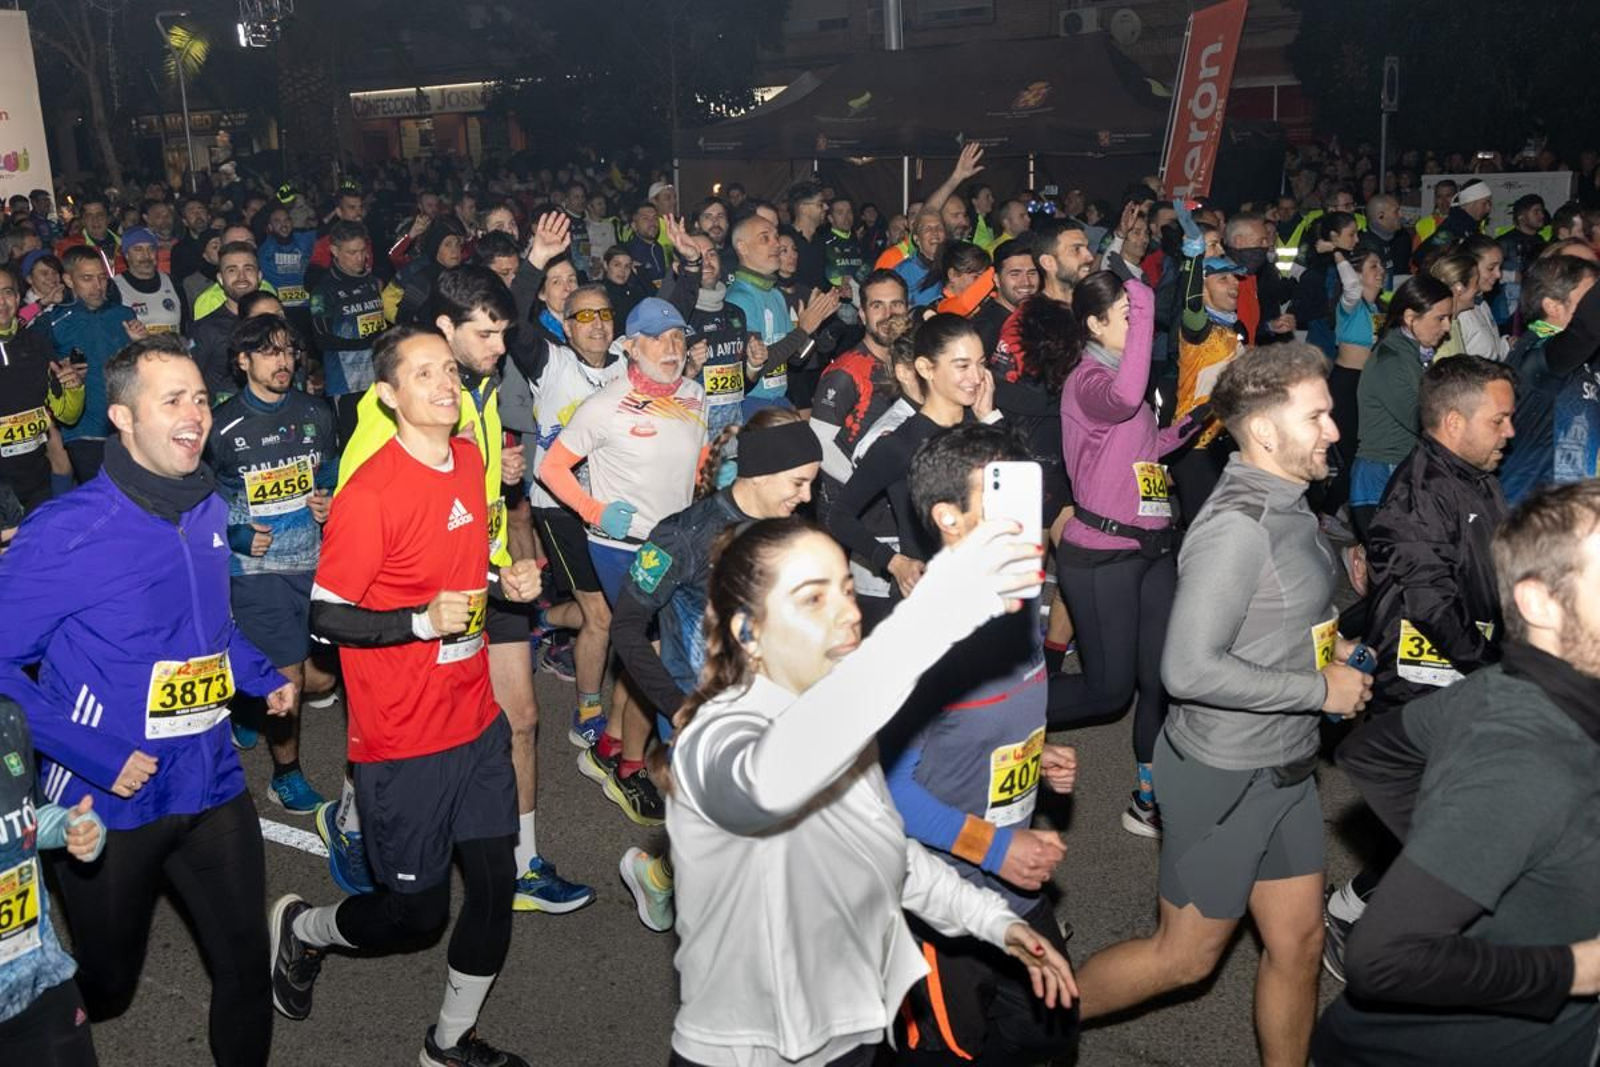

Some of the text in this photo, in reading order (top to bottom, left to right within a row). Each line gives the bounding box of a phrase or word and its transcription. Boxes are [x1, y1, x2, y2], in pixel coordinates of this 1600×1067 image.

[353, 93, 431, 117] CONFECCIONS
[342, 303, 362, 315] SAN
[709, 374, 742, 390] 3280
[4, 420, 47, 440] 4190
[254, 474, 309, 499] 4456
[159, 673, 229, 708] 3873
